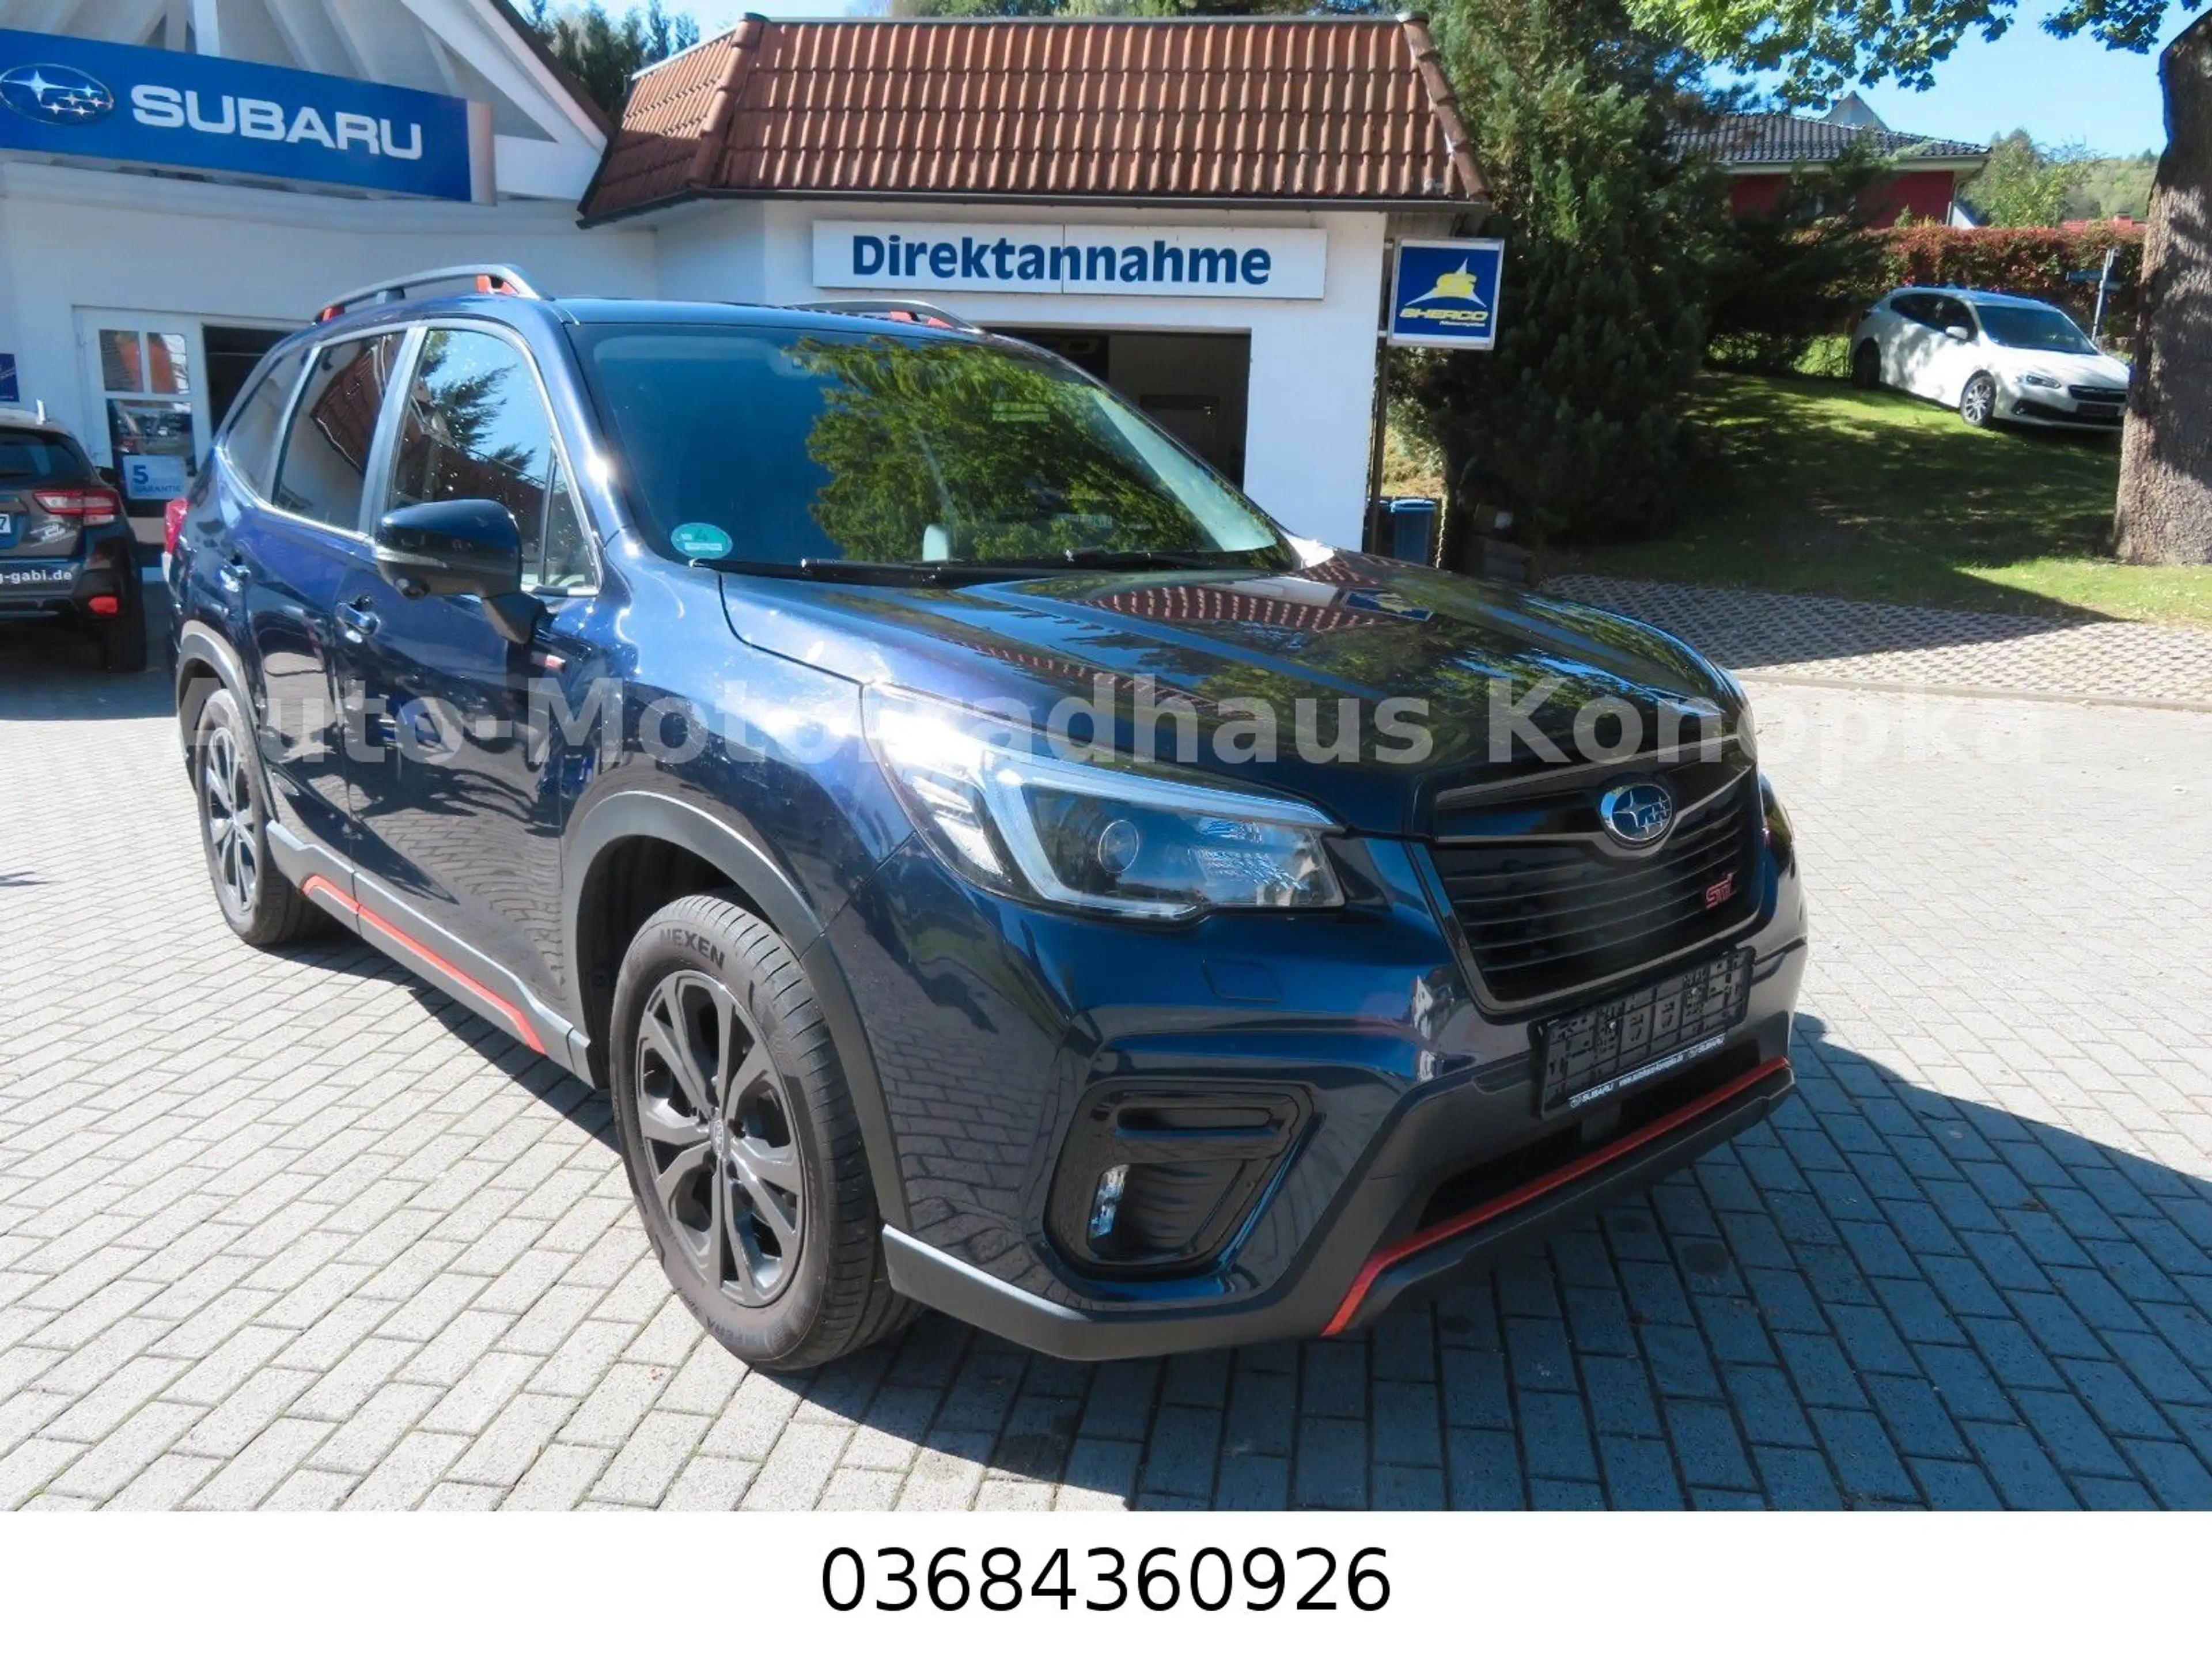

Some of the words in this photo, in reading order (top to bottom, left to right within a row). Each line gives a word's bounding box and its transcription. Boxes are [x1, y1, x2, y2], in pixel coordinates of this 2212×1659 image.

[131, 84, 423, 160] SUBARU
[853, 234, 1271, 285] Direktannahme
[1399, 308, 1488, 321] SHERCO
[132, 464, 149, 484] 5
[660, 927, 725, 971] NEXEN
